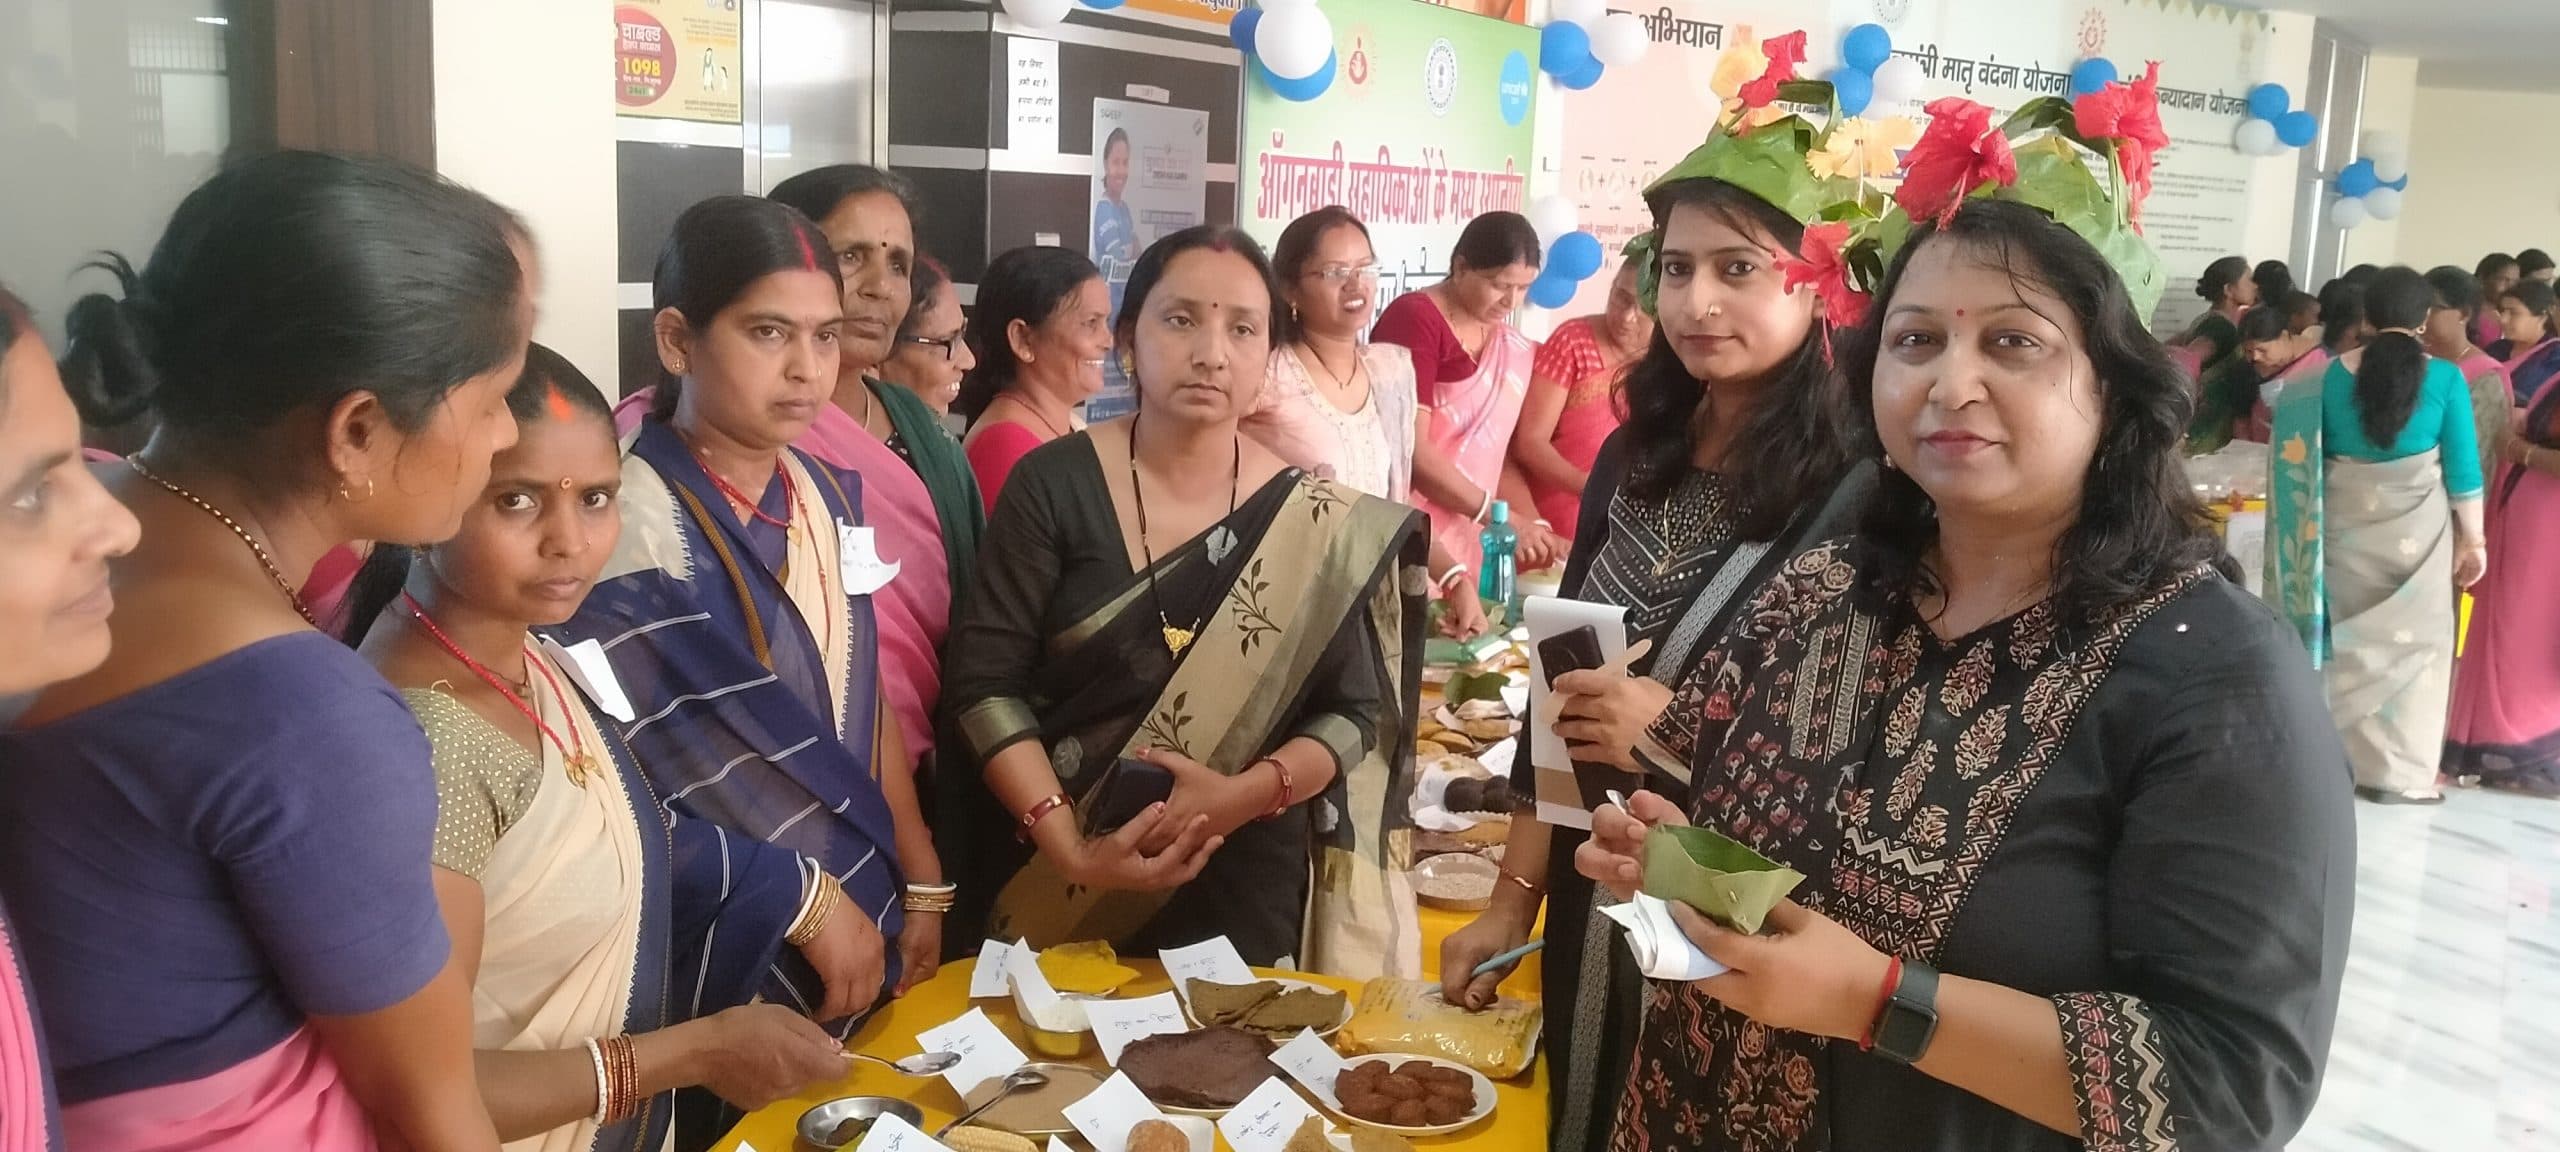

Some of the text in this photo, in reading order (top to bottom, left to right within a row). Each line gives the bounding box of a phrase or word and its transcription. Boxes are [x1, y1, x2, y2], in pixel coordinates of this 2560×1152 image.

[623, 57, 661, 77] 1098
[1942, 57, 1975, 95] मातृ
[1978, 54, 2020, 91] वंदना
[2023, 60, 2072, 96] योजना
